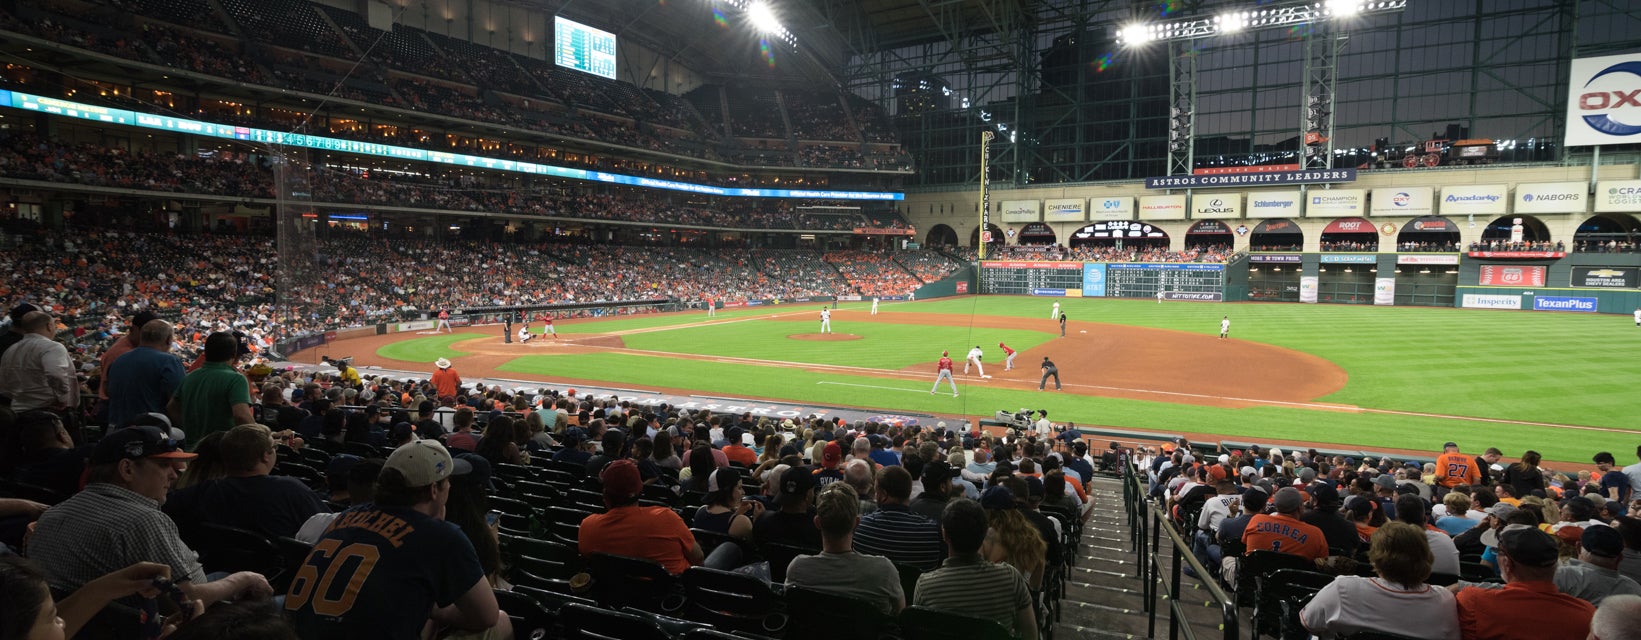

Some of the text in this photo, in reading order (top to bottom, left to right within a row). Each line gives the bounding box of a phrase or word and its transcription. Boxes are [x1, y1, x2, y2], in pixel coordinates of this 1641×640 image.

[306, 136, 313, 146] 6
[316, 137, 321, 147] 7
[325, 138, 331, 148] 8
[334, 139, 340, 149] 9
[1152, 171, 1348, 186] ASTROS COMMUNITY LEADERS
[1445, 194, 1500, 202] Anadarko
[1536, 193, 1580, 201] NABORS
[1254, 200, 1293, 209] Schlumberger
[1505, 273, 1519, 281] 66
[1477, 297, 1517, 306] Insperity
[1537, 298, 1593, 309] TexanPlus
[1448, 463, 1468, 478] 27
[819, 476, 840, 486] RYAN
[1257, 521, 1309, 545] CORREA
[1272, 540, 1282, 552] 1
[285, 538, 380, 617] 60
